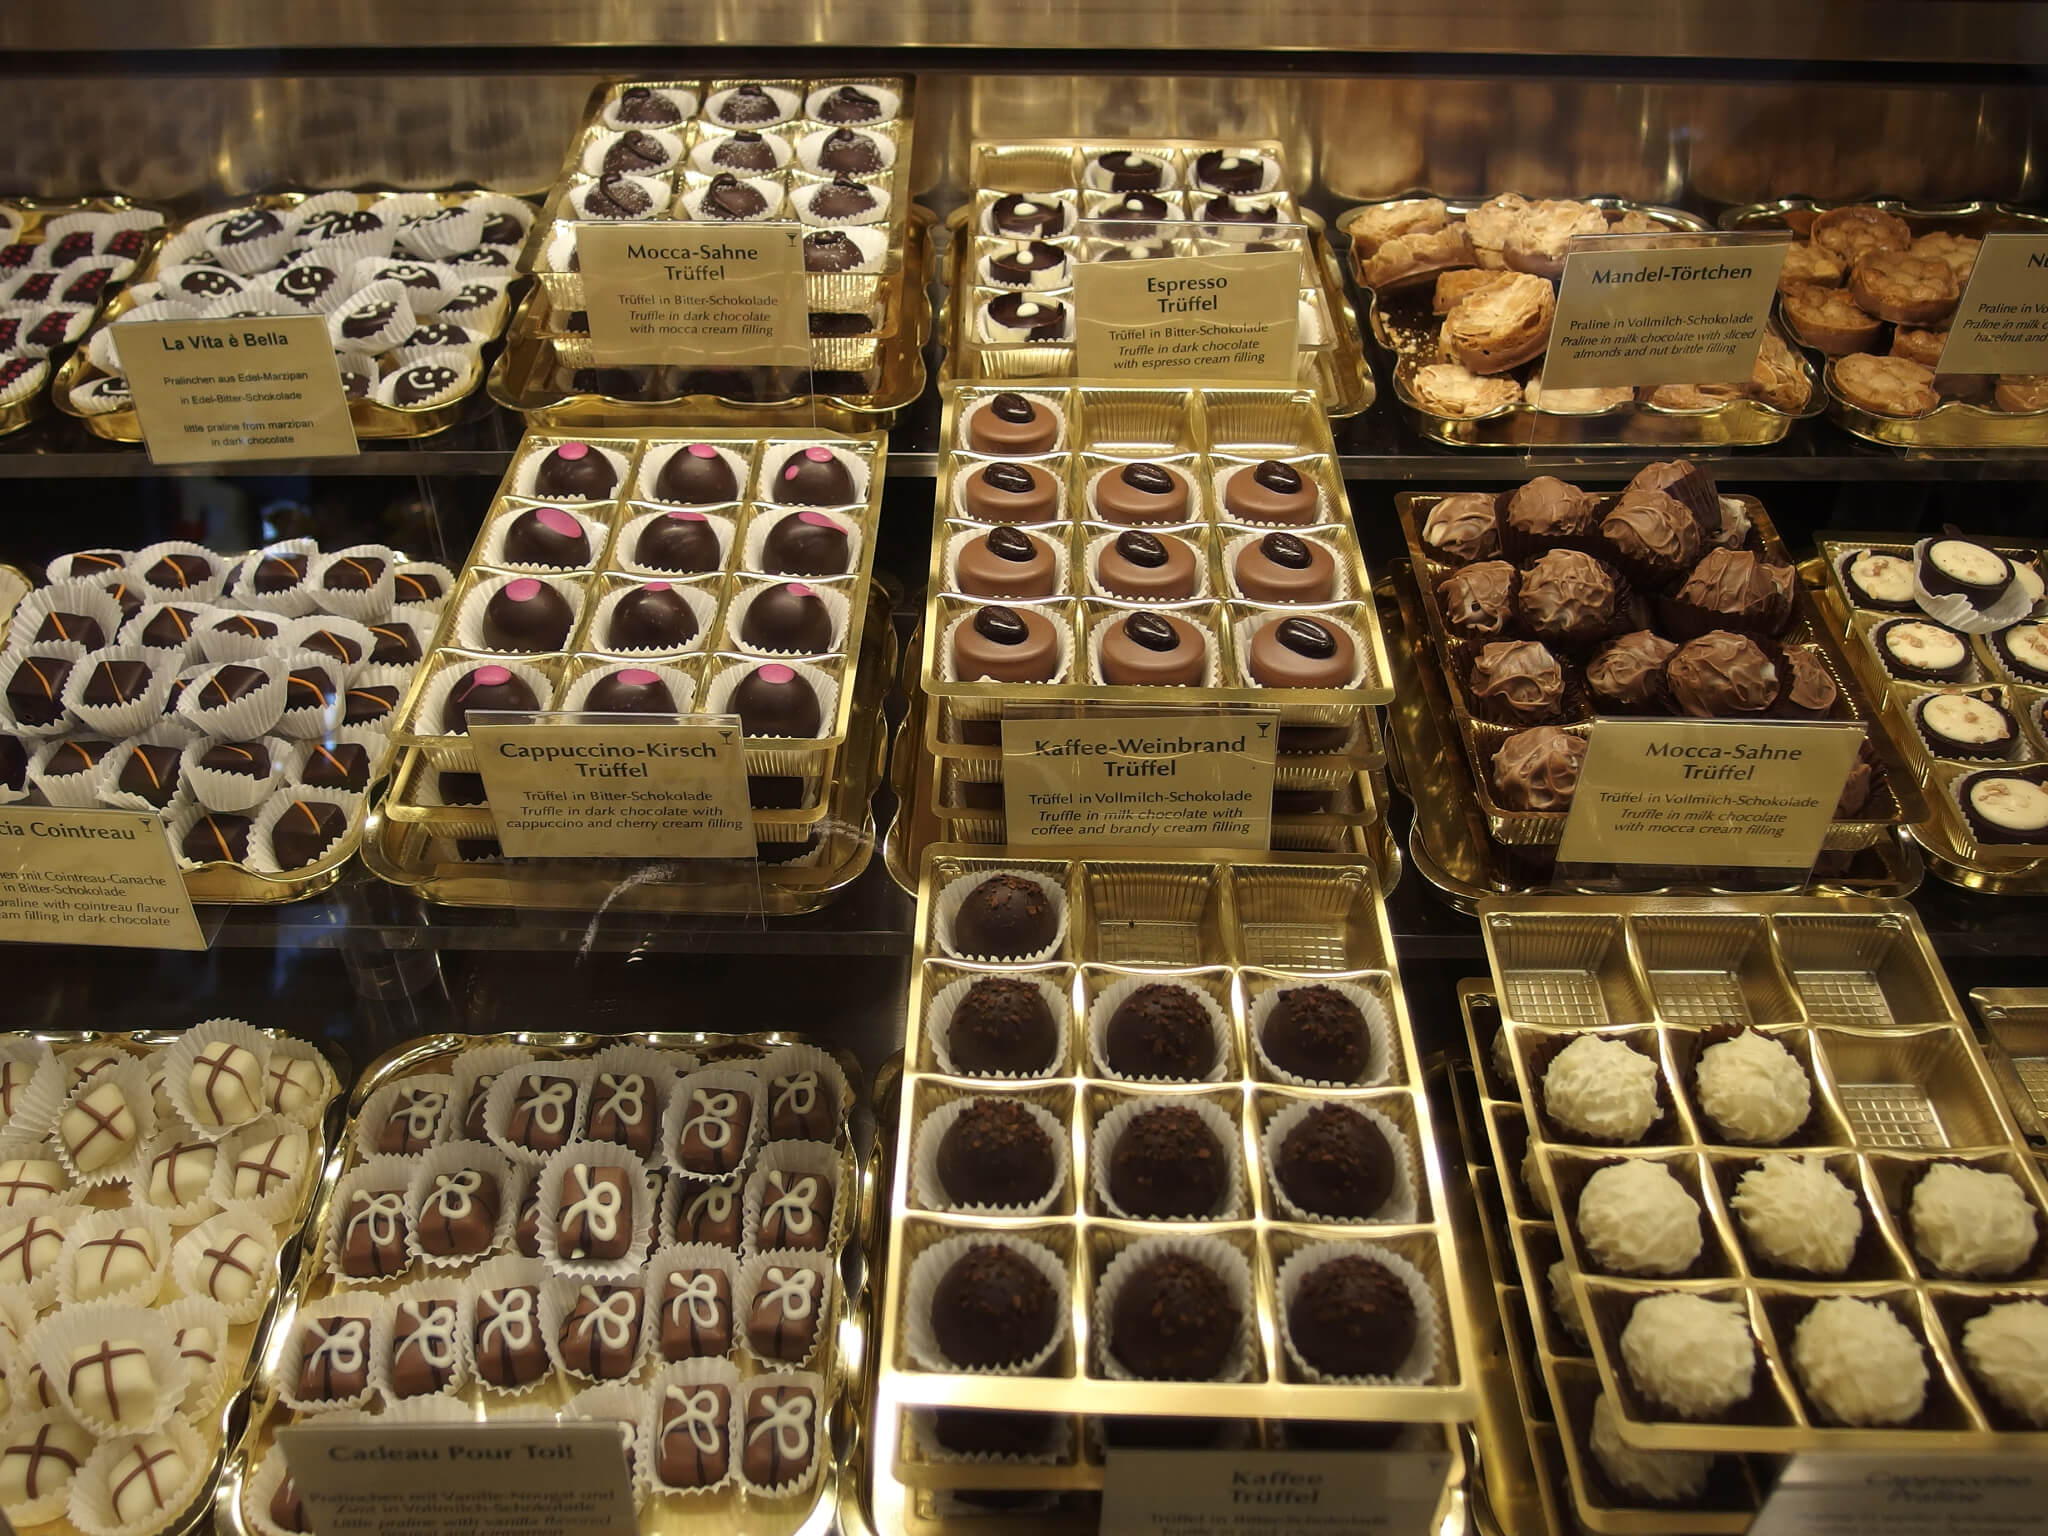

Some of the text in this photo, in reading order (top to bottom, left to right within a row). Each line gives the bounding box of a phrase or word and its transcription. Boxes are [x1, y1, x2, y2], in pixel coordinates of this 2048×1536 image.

[627, 244, 758, 260] Mocca-Sahne
[664, 265, 725, 281] Trüffel
[1592, 264, 1752, 284] Mandel-Törtchen
[1147, 276, 1227, 296] Espresso
[617, 295, 778, 306] Trüffel in Bitter-Schokolade
[1157, 295, 1217, 313] Trüffel
[1978, 304, 2048, 313] Praline in Vo
[629, 311, 771, 322] Truffle in dark chocolate
[1570, 314, 1753, 330] Praline in Vollmilch-Schokolade
[1963, 319, 2000, 329] Praline
[2002, 320, 2013, 329] in
[2016, 320, 2039, 329] milk
[630, 325, 655, 334] with
[702, 327, 738, 335] cream
[741, 325, 773, 336] filling
[1109, 322, 1269, 341] Trüffel in Bitter-Schokolade
[1561, 328, 1757, 347] Praline in milk chocolate with sliced
[1974, 333, 2023, 342] hazelnut
[162, 333, 288, 351] La Vita è Bella
[1119, 339, 1260, 356] Truffle in dark chocolate
[1573, 343, 1736, 359] almonds and nut brittle filling
[1114, 351, 1265, 369] with espresso cream filling
[164, 376, 215, 385] Pralinchen
[238, 371, 308, 383] Edel-Marzipan
[181, 396, 189, 405] in
[184, 420, 314, 434] little praline from marzipan
[211, 438, 220, 446] in
[247, 435, 294, 445] chocolate
[500, 742, 717, 761] Cappuccino-Kirsch
[1035, 736, 1245, 756] Kaffee-Weinbrand
[1645, 742, 1802, 761] Mocca-Sahne
[576, 762, 648, 778] Trüffel
[1103, 760, 1177, 777] Trüffel
[1682, 764, 1755, 781] Trüffel
[523, 790, 712, 802] Trüffel in Bitter-Schokolade
[1029, 790, 1252, 805] Trüffel in Vollmilch-Schokolade
[1599, 791, 1819, 808] Trüffel in Vollmilch-Schokolade
[520, 806, 723, 816] Truffle in dark chocolate with
[1039, 808, 1243, 822] Truffle in milk chocolate with
[1620, 808, 1788, 823] Truffle in milk chocolate
[31, 822, 135, 840] Cointreau
[506, 818, 743, 831] cappuccino and cherry cream filling
[1031, 821, 1250, 836] coffee and brandy cream filling
[1613, 822, 1785, 838] with mocca cream filling
[45, 872, 166, 886] Cointreau-Ganache
[4, 883, 128, 897] in Bitter-Schokolade
[43, 900, 71, 910] with
[74, 902, 133, 913] cointreau
[137, 903, 180, 914] flavour
[0, 910, 171, 926] am filling in dark chocolate
[328, 1444, 439, 1462] Cadeau
[448, 1445, 513, 1461] Pour
[1232, 1470, 1324, 1487] Kaffee
[1231, 1487, 1319, 1506] Trüffel
